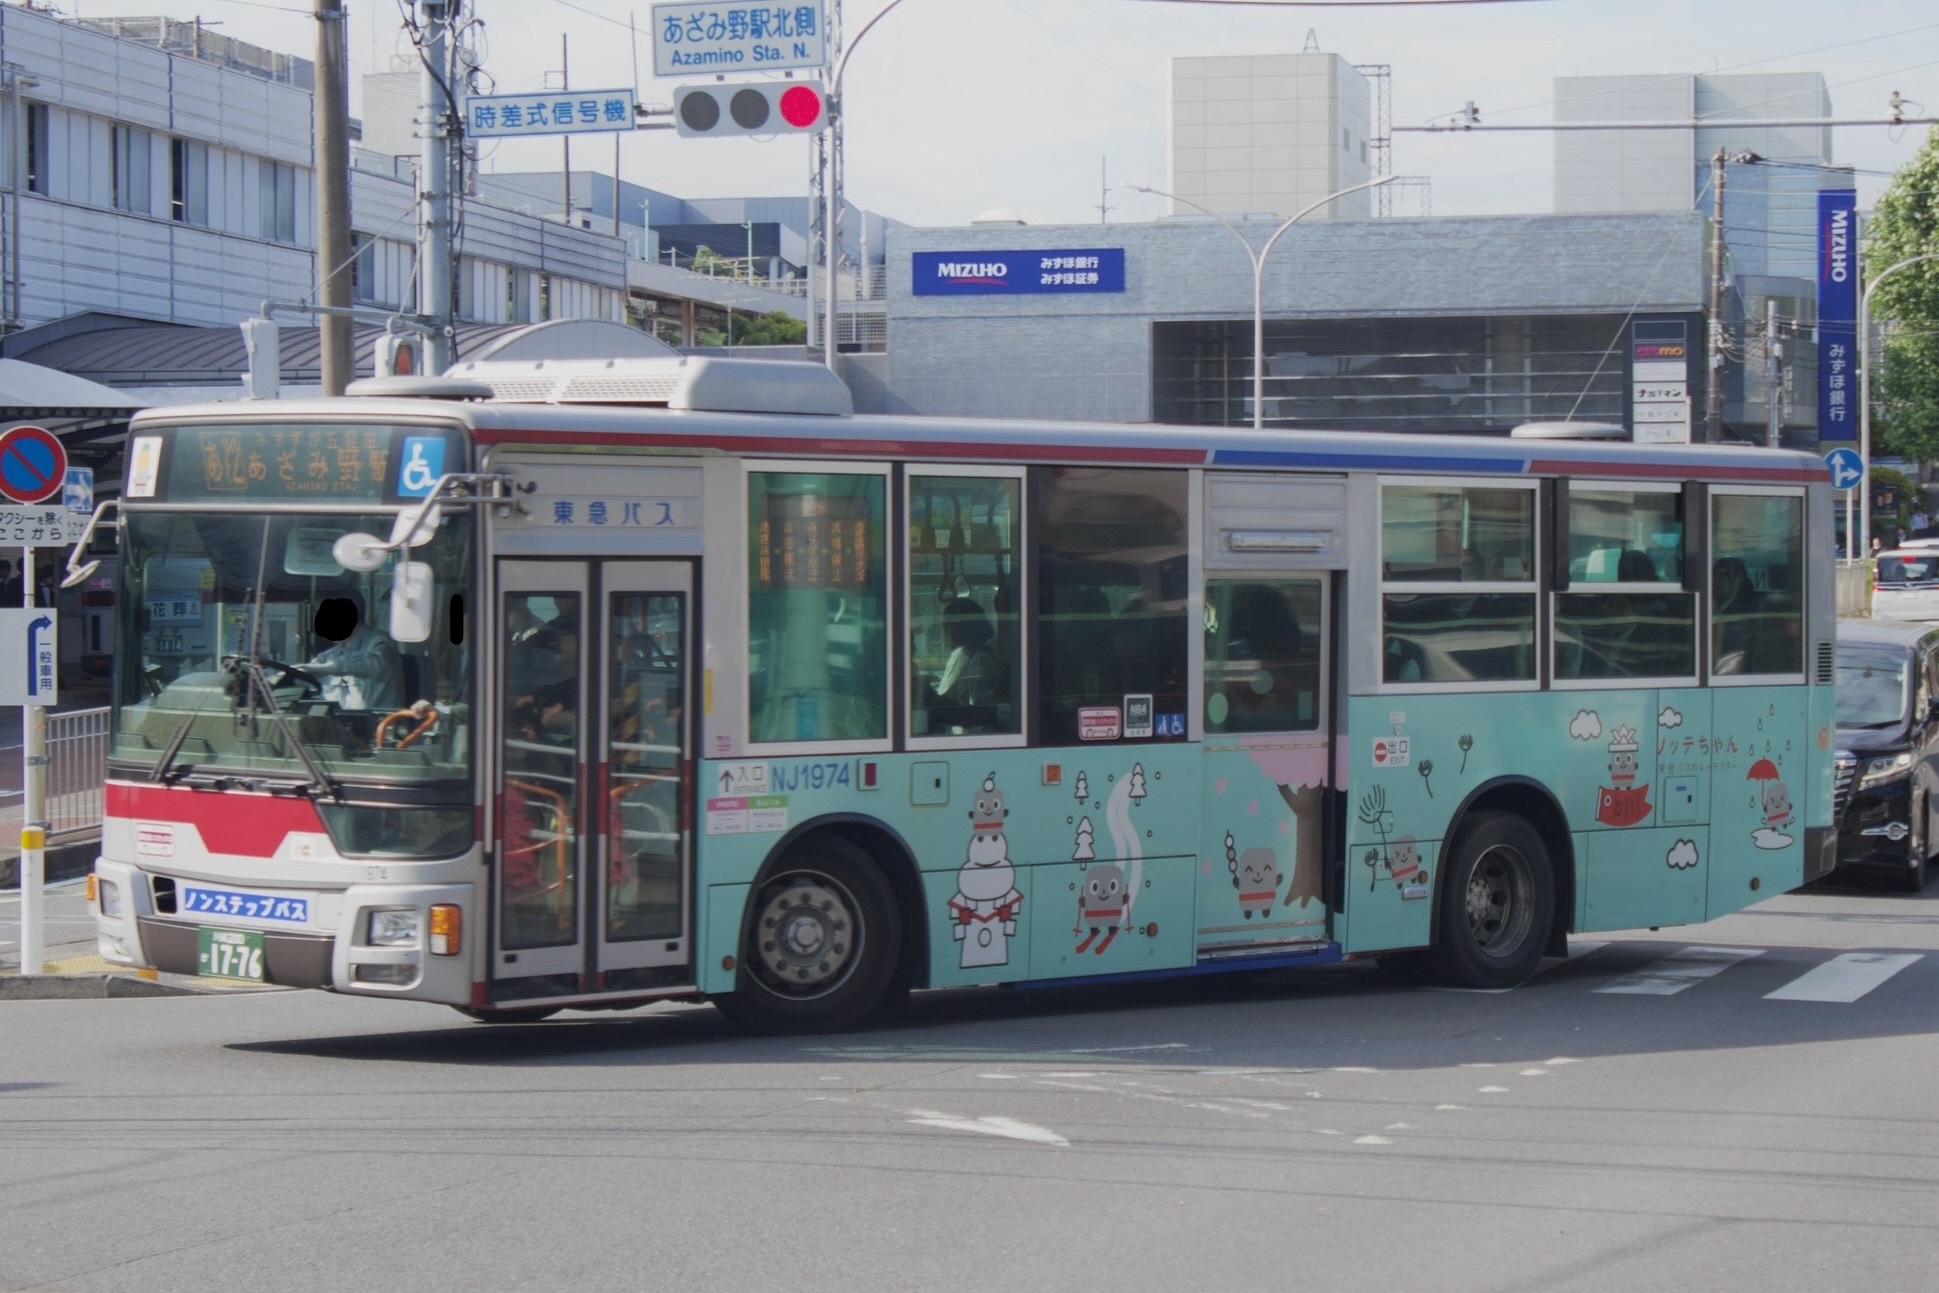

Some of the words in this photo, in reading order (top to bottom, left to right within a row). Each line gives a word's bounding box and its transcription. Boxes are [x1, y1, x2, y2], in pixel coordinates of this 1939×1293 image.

[663, 7, 816, 44] あざみ野駅北側
[671, 46, 744, 66] Azamino
[753, 45, 785, 62] Sta.
[794, 42, 811, 59] N.
[475, 99, 627, 129] 時差式信号機
[1831, 210, 1848, 283] MIZUHO
[938, 263, 1008, 278] MIZUHO
[1040, 257, 1099, 269] みずほ銀行
[1829, 344, 1846, 422] みずほ銀行
[552, 501, 675, 526] 東急バス
[39, 641, 52, 691] 一般車用
[1388, 740, 1408, 754] 出口
[1657, 734, 1739, 756] ノッテちゃん
[738, 766, 763, 782] 入口
[1390, 756, 1405, 765] EXIT
[772, 762, 850, 792] NJ1974
[185, 889, 307, 921] ノンステップバス
[211, 943, 262, 978] 17-76
